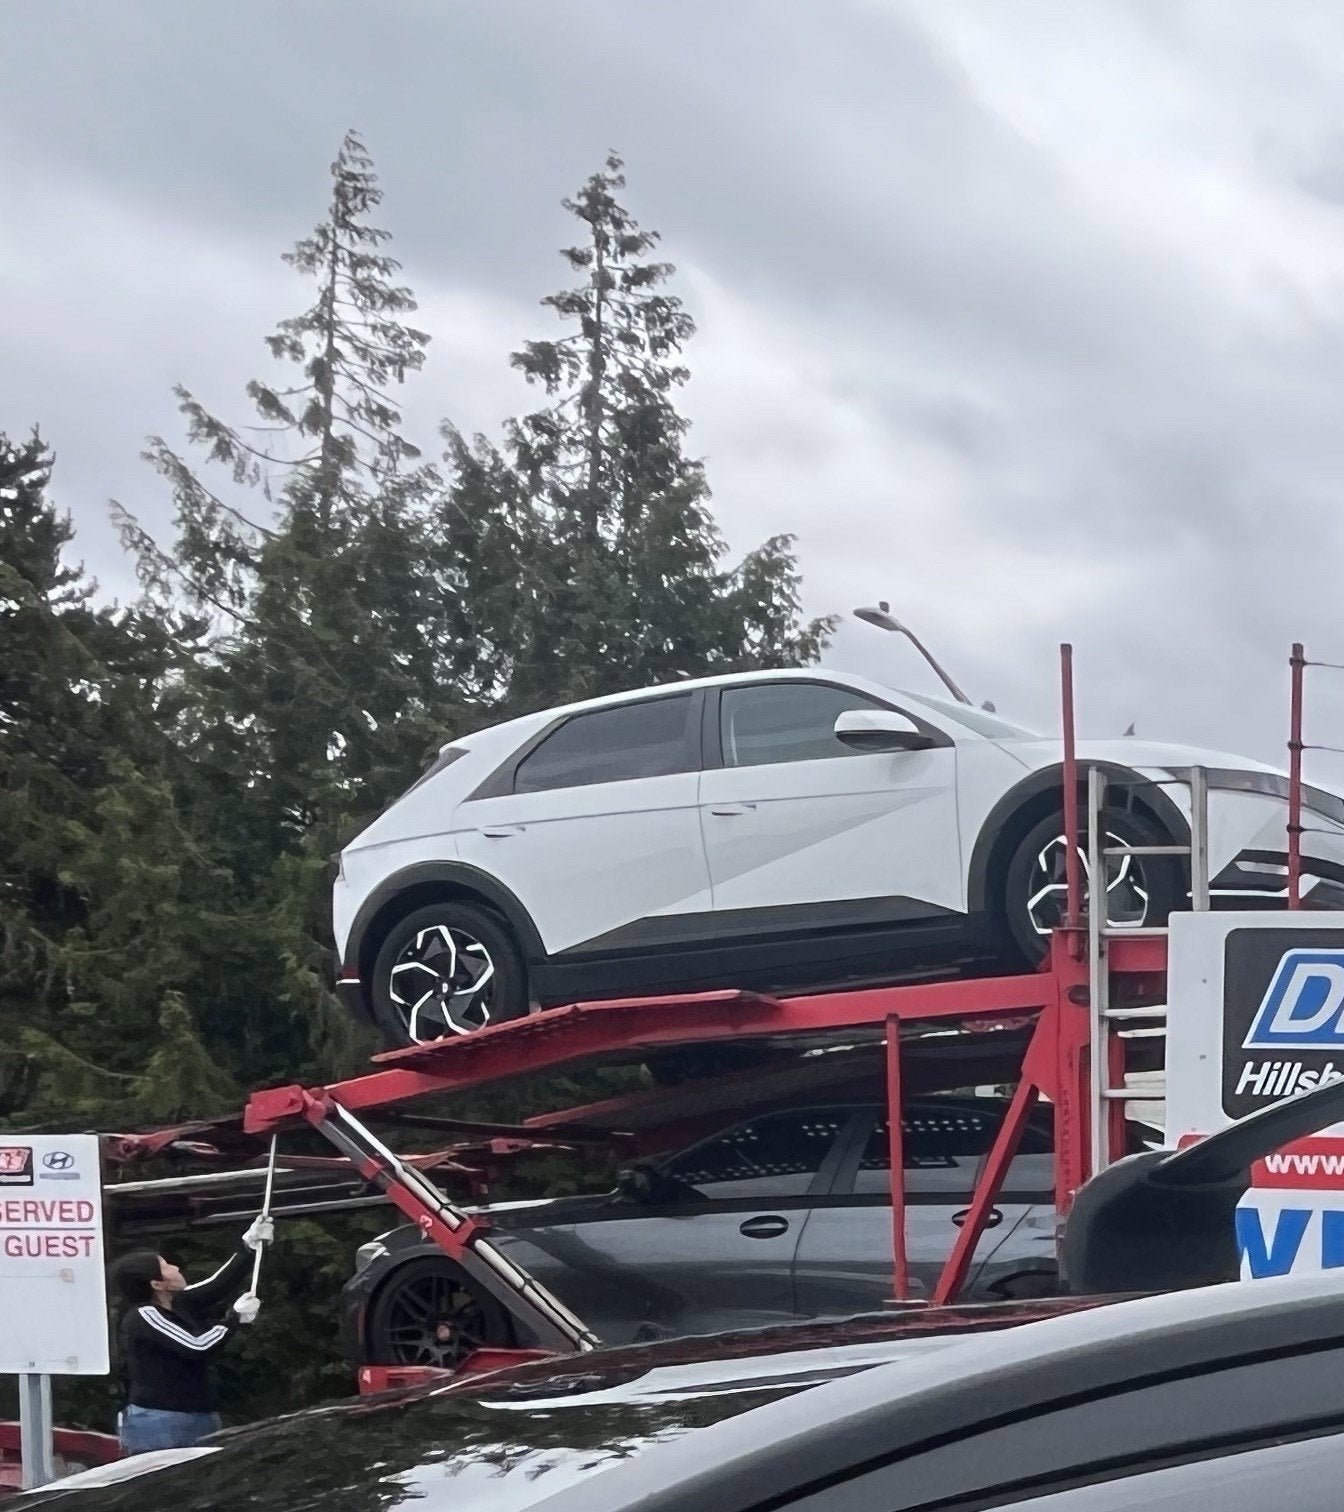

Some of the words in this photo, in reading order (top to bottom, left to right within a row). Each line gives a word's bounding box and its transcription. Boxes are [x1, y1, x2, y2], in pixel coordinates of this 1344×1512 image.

[1235, 1061, 1343, 1097] Hillsb
[0, 1200, 94, 1223] ERVED
[4, 1234, 96, 1258] GUEST
